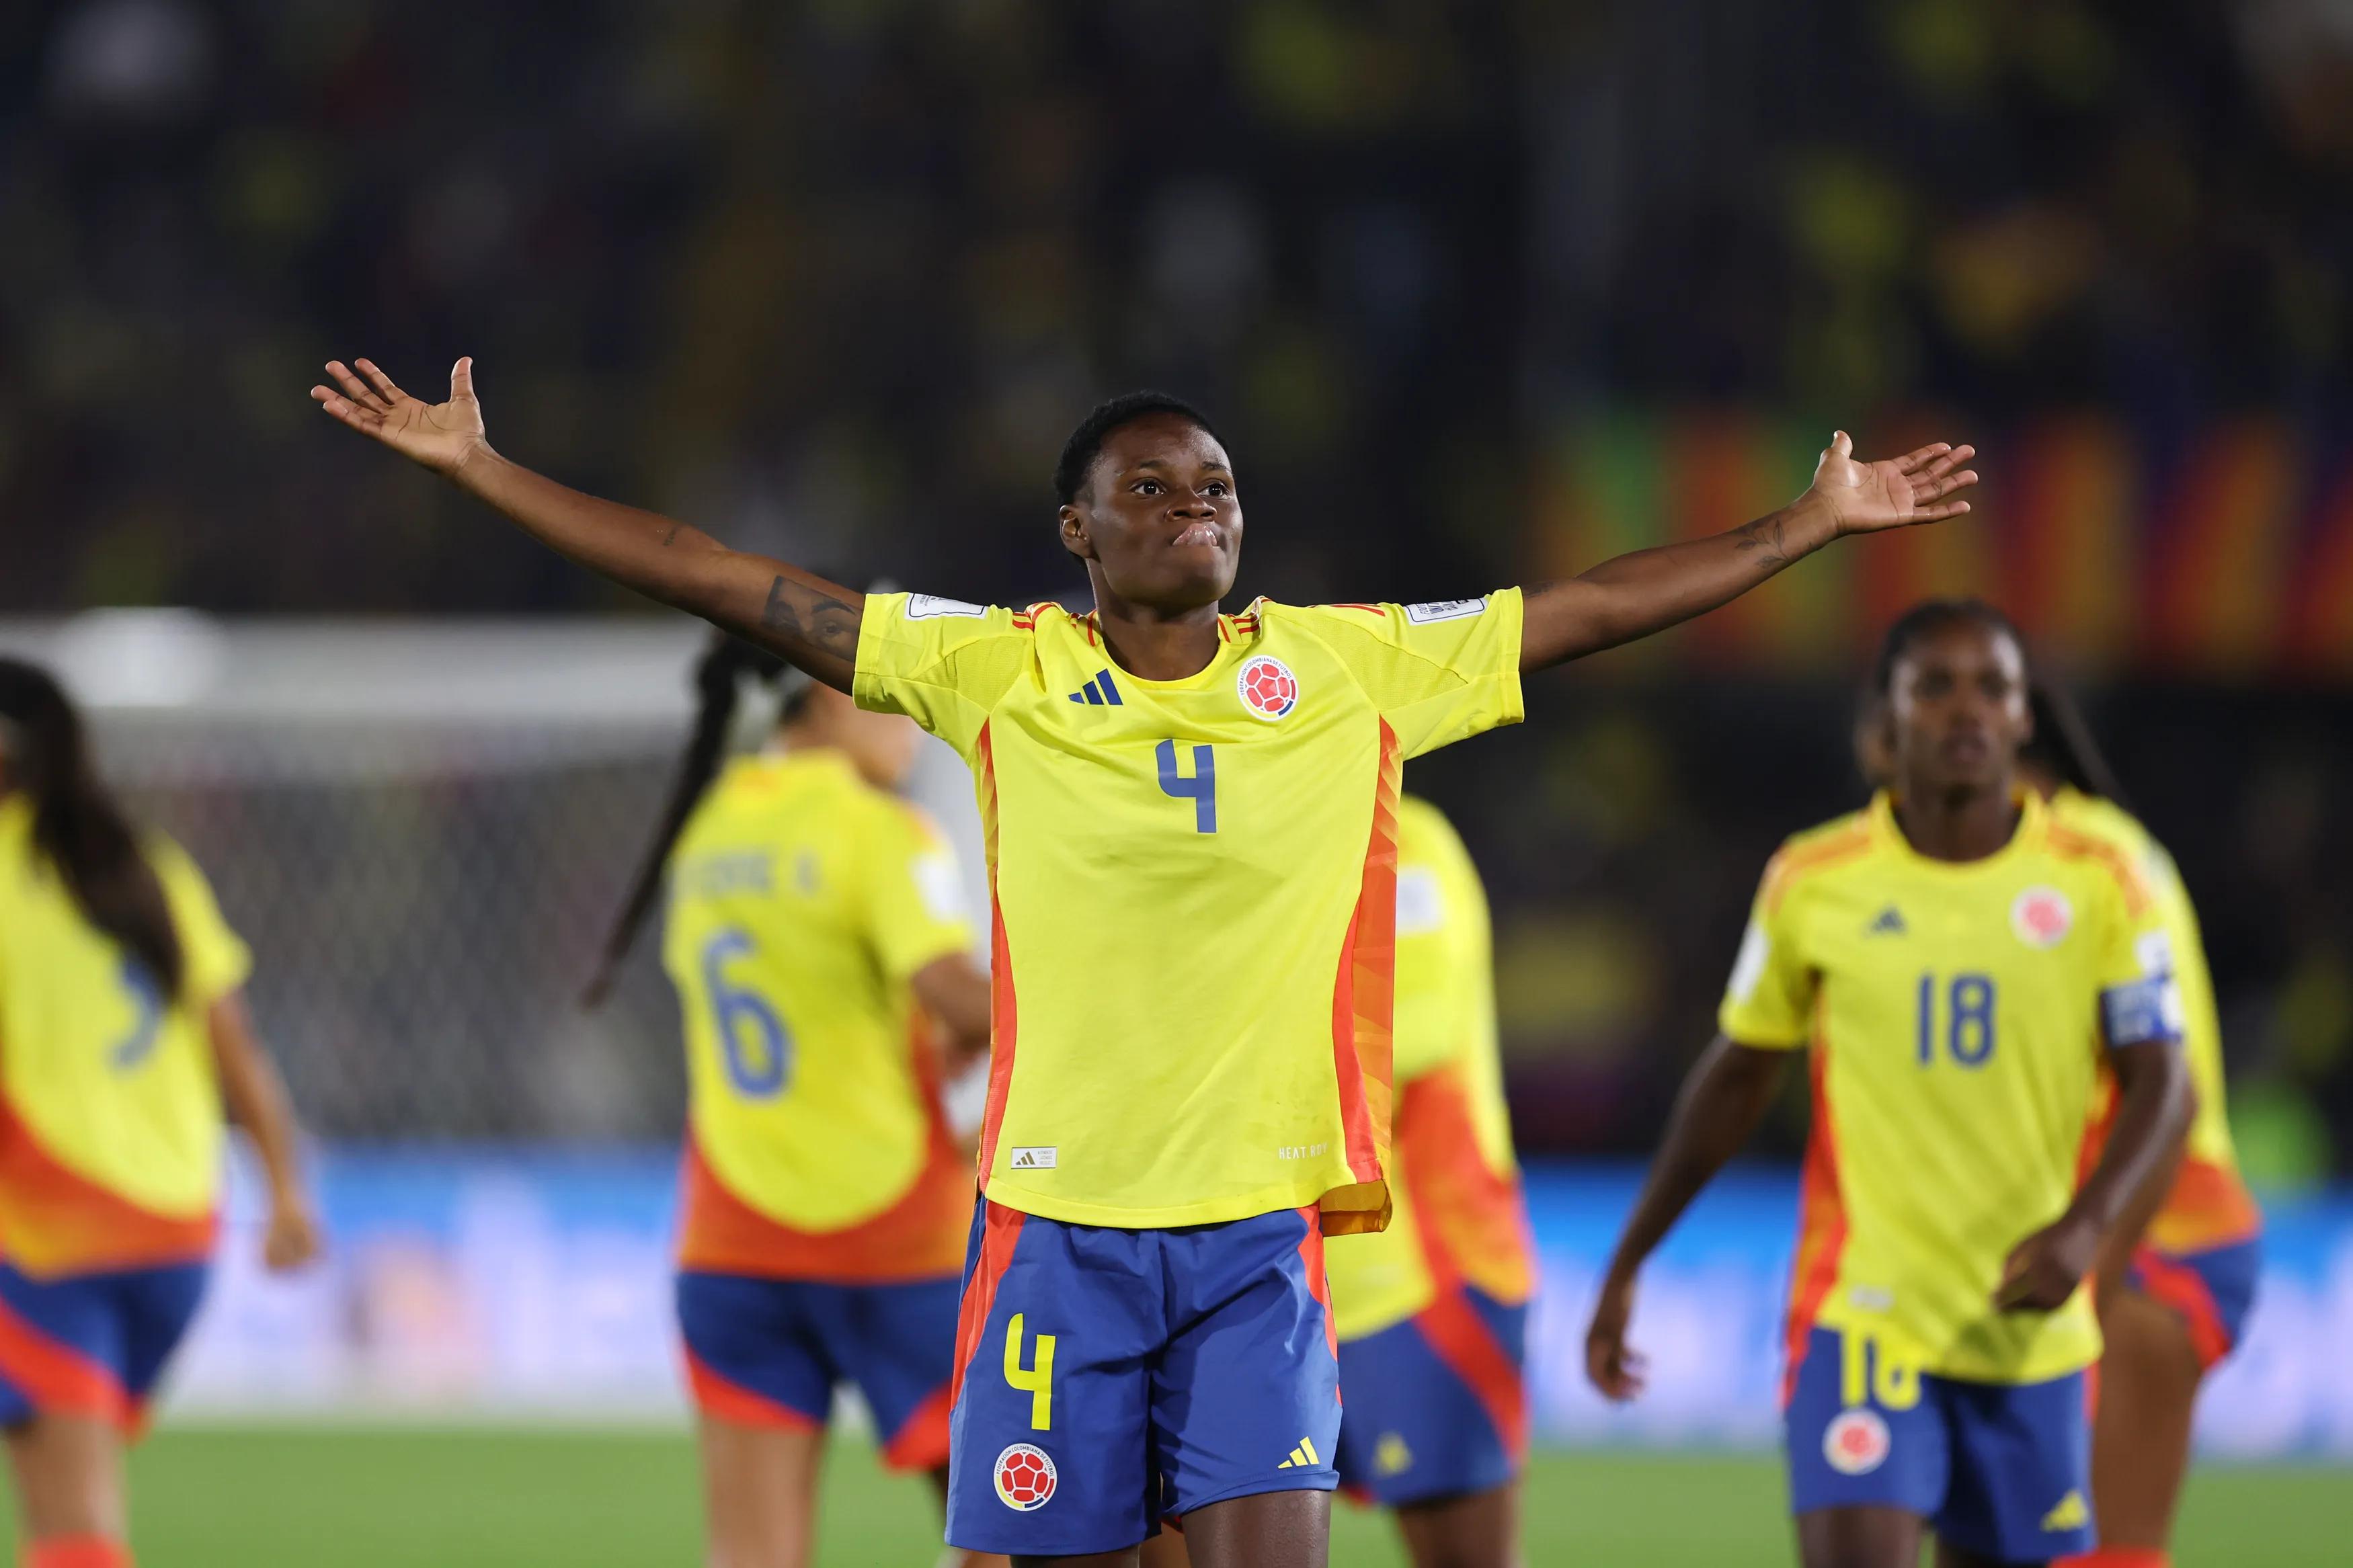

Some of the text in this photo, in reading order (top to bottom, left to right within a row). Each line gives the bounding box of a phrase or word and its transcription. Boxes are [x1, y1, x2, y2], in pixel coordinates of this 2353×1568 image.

[1246, 657, 1272, 669] COLOMBIANA
[1155, 739, 1216, 833] 4
[702, 925, 793, 1100] 6
[1915, 971, 1998, 1071] 18
[1004, 1313, 1055, 1431] 4
[1011, 1446, 1041, 1456] COLOMBIANA
